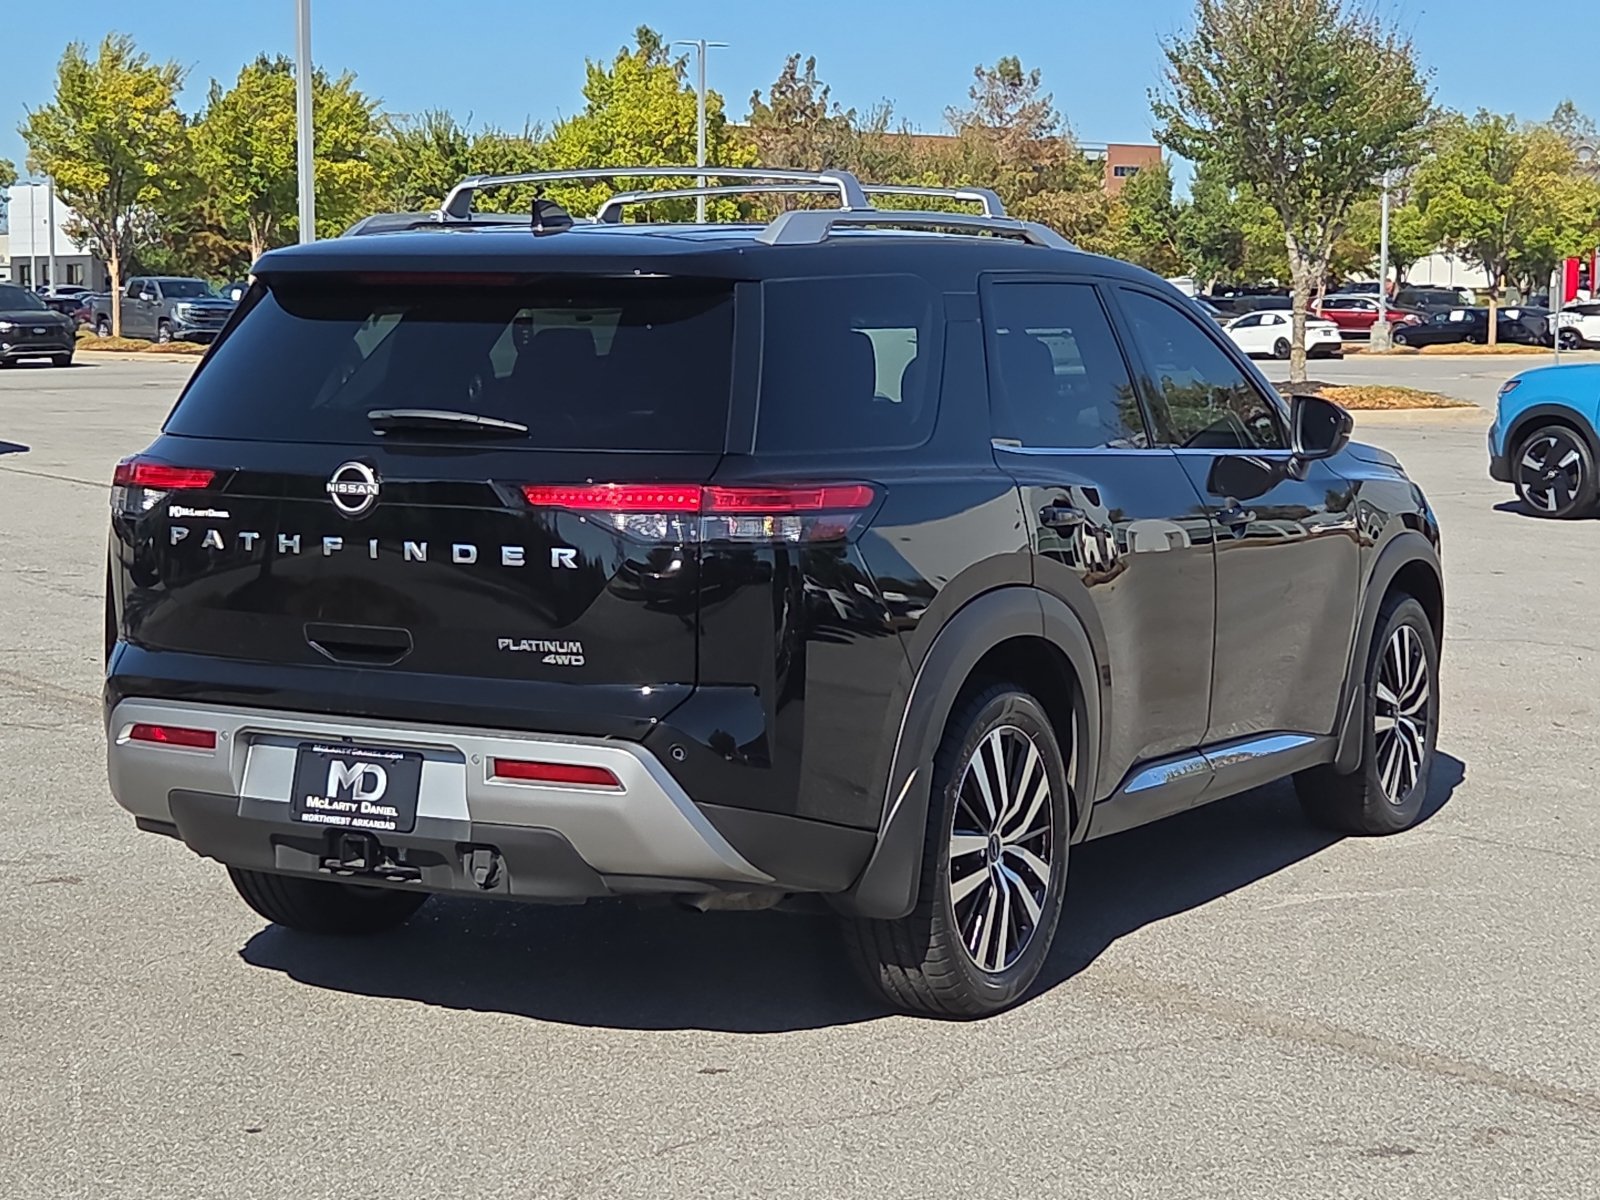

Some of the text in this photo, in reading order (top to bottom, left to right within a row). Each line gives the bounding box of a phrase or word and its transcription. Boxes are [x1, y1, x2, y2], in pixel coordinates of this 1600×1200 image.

[326, 483, 379, 495] NISSAN
[170, 526, 578, 568] PATHFINDER
[498, 638, 583, 653] PLATINUM
[542, 654, 585, 665] 4WD
[327, 760, 388, 801] MD
[361, 802, 398, 817] DANIEL
